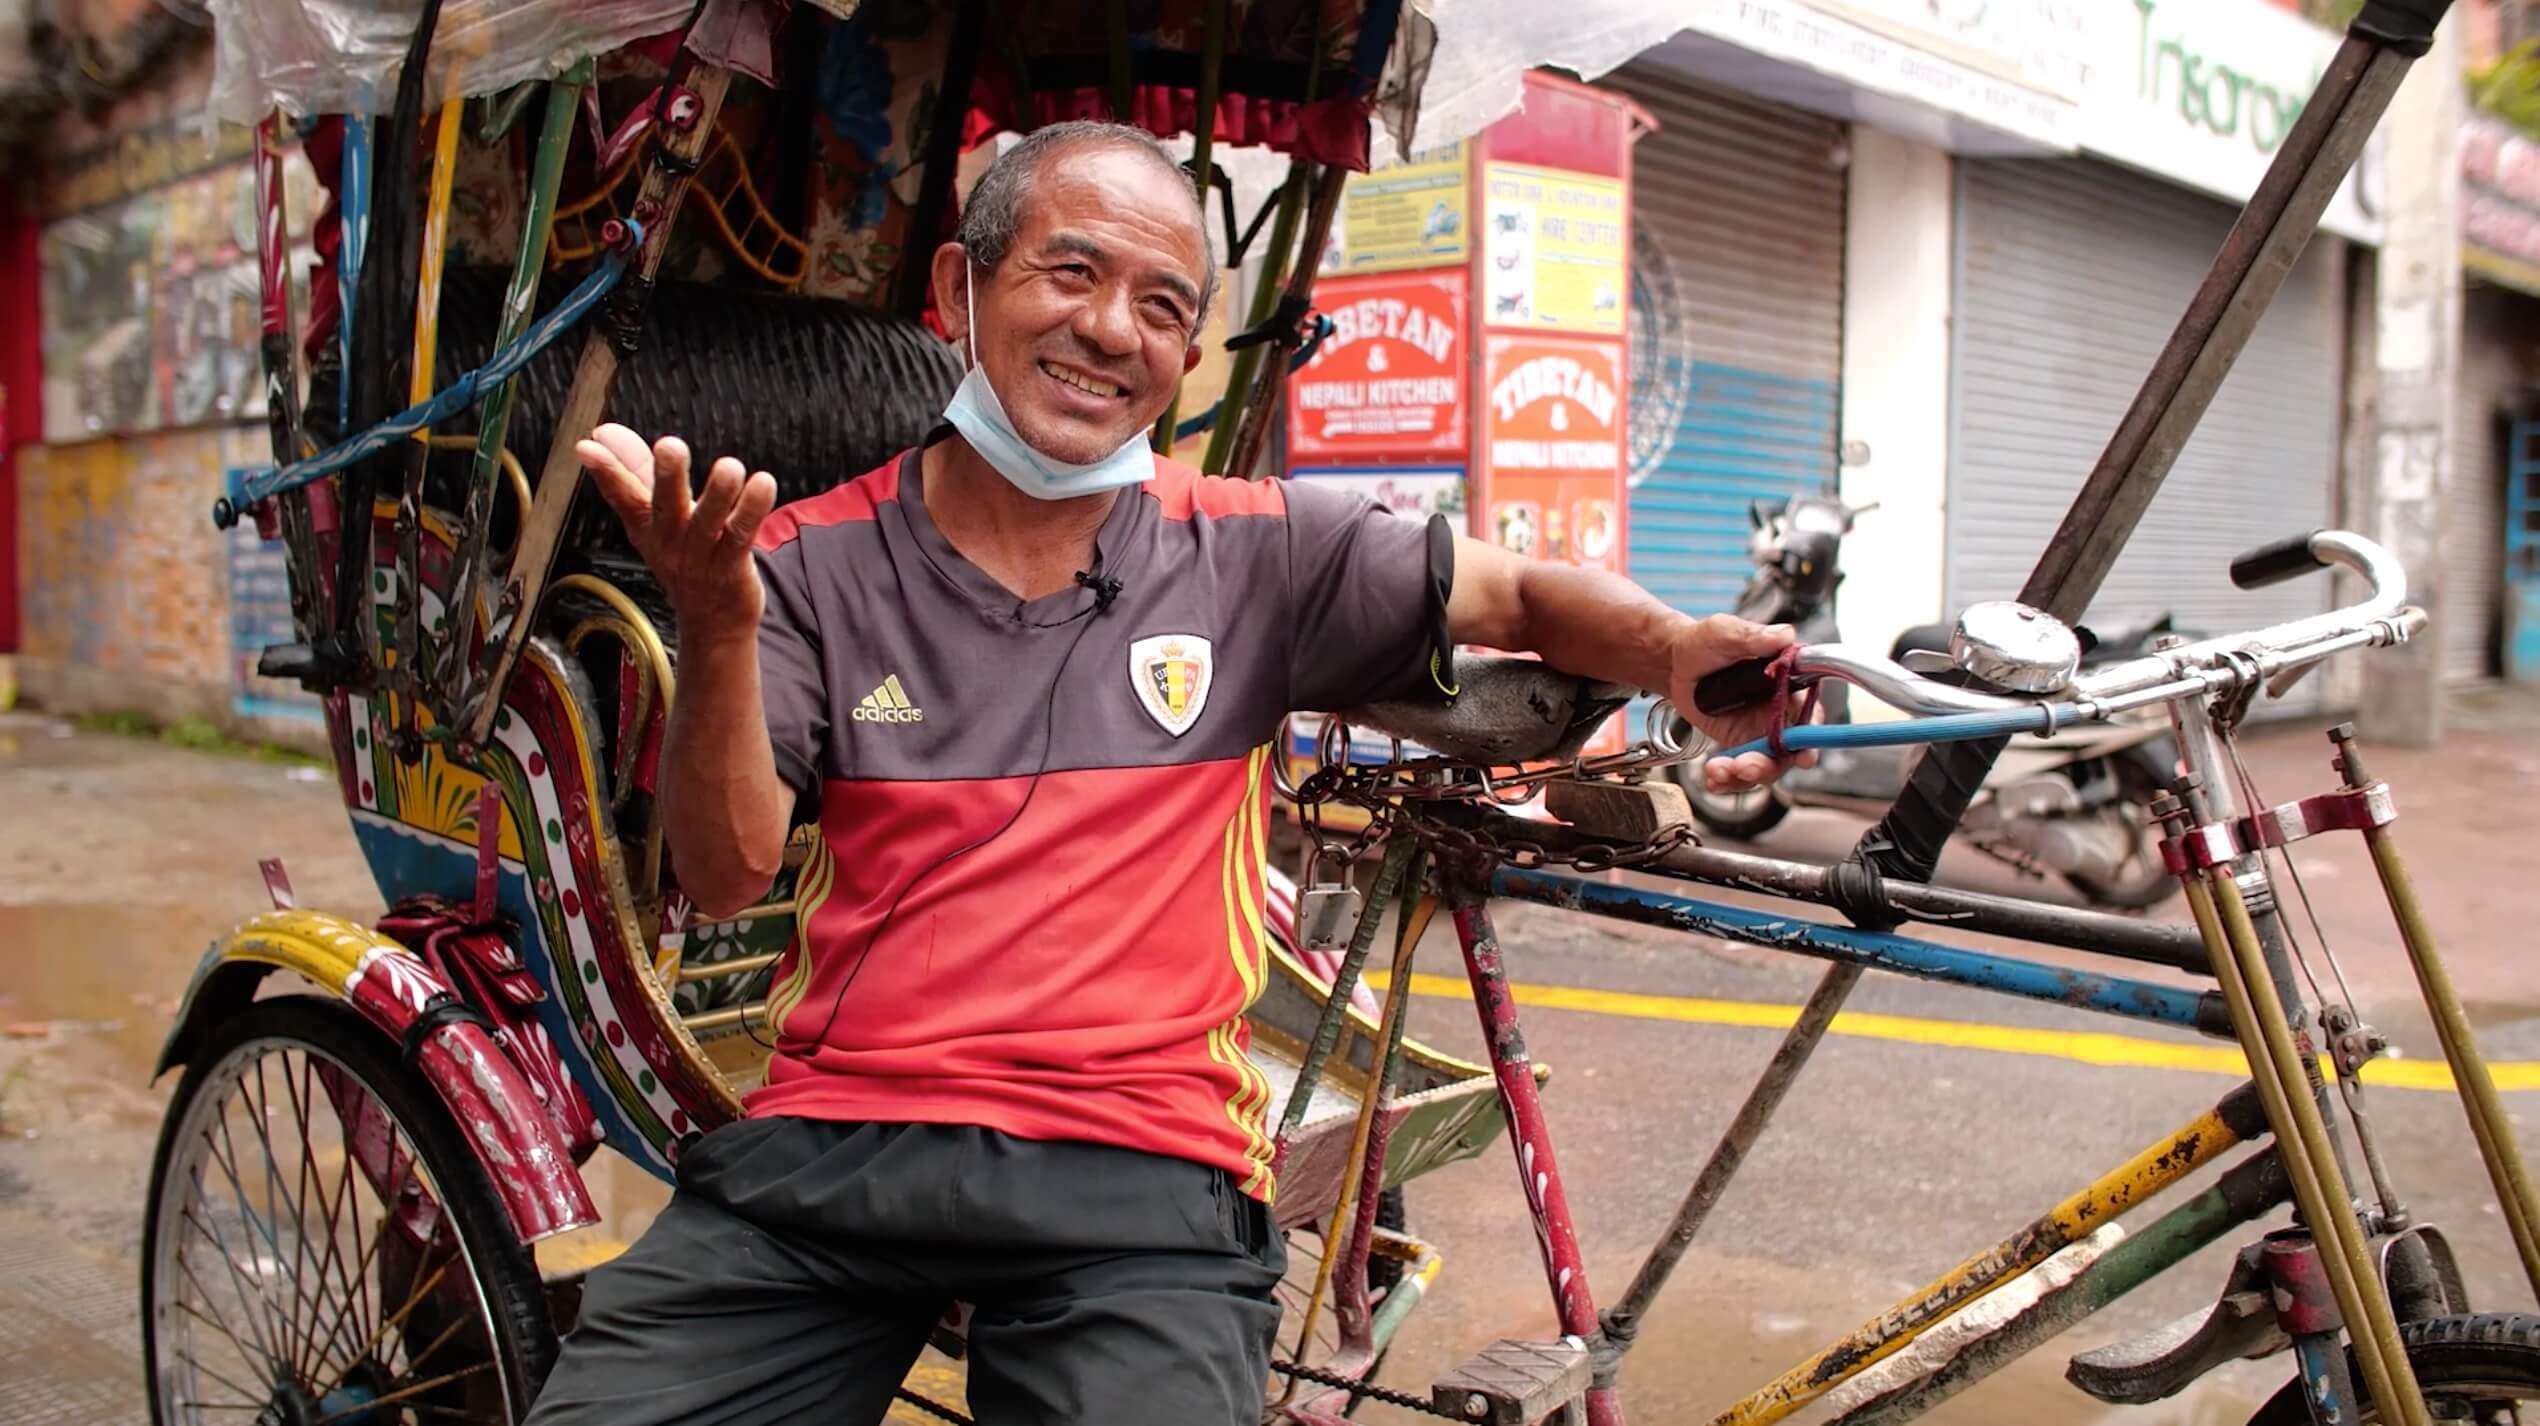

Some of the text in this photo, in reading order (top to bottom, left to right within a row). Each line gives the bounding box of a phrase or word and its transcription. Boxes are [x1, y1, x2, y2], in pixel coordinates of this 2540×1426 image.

[1309, 298, 1455, 368] BETAN
[1366, 344, 1389, 372] &
[1300, 376, 1456, 410] NEPALI KITCHEN
[1491, 356, 1616, 430] TIBETAN
[852, 706, 923, 722] adidas
